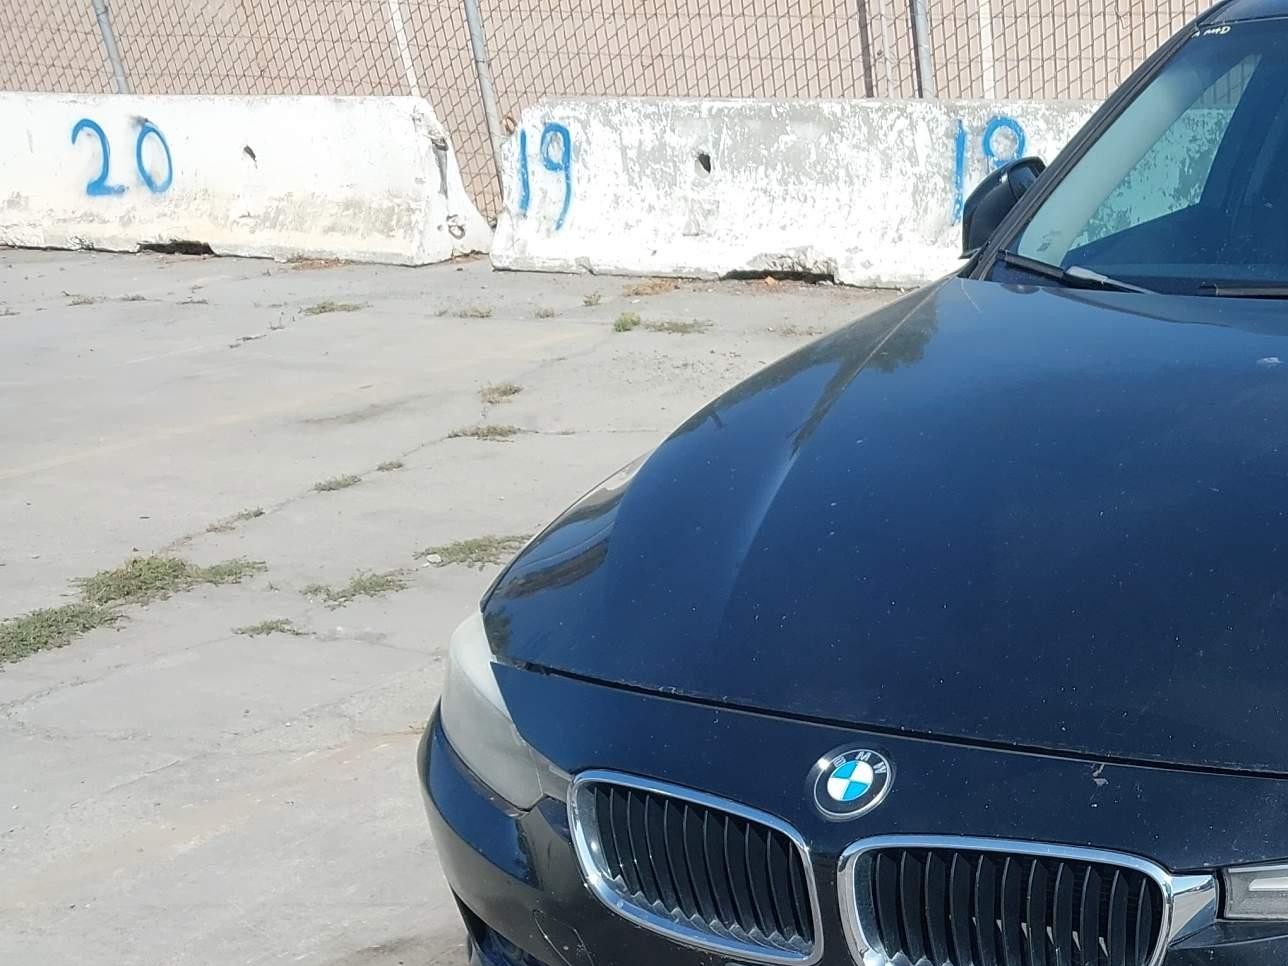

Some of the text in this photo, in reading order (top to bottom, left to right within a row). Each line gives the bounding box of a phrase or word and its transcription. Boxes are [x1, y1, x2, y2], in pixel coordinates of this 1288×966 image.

[71, 117, 173, 196] 20
[519, 121, 572, 231] 19
[832, 751, 887, 774] BMW
